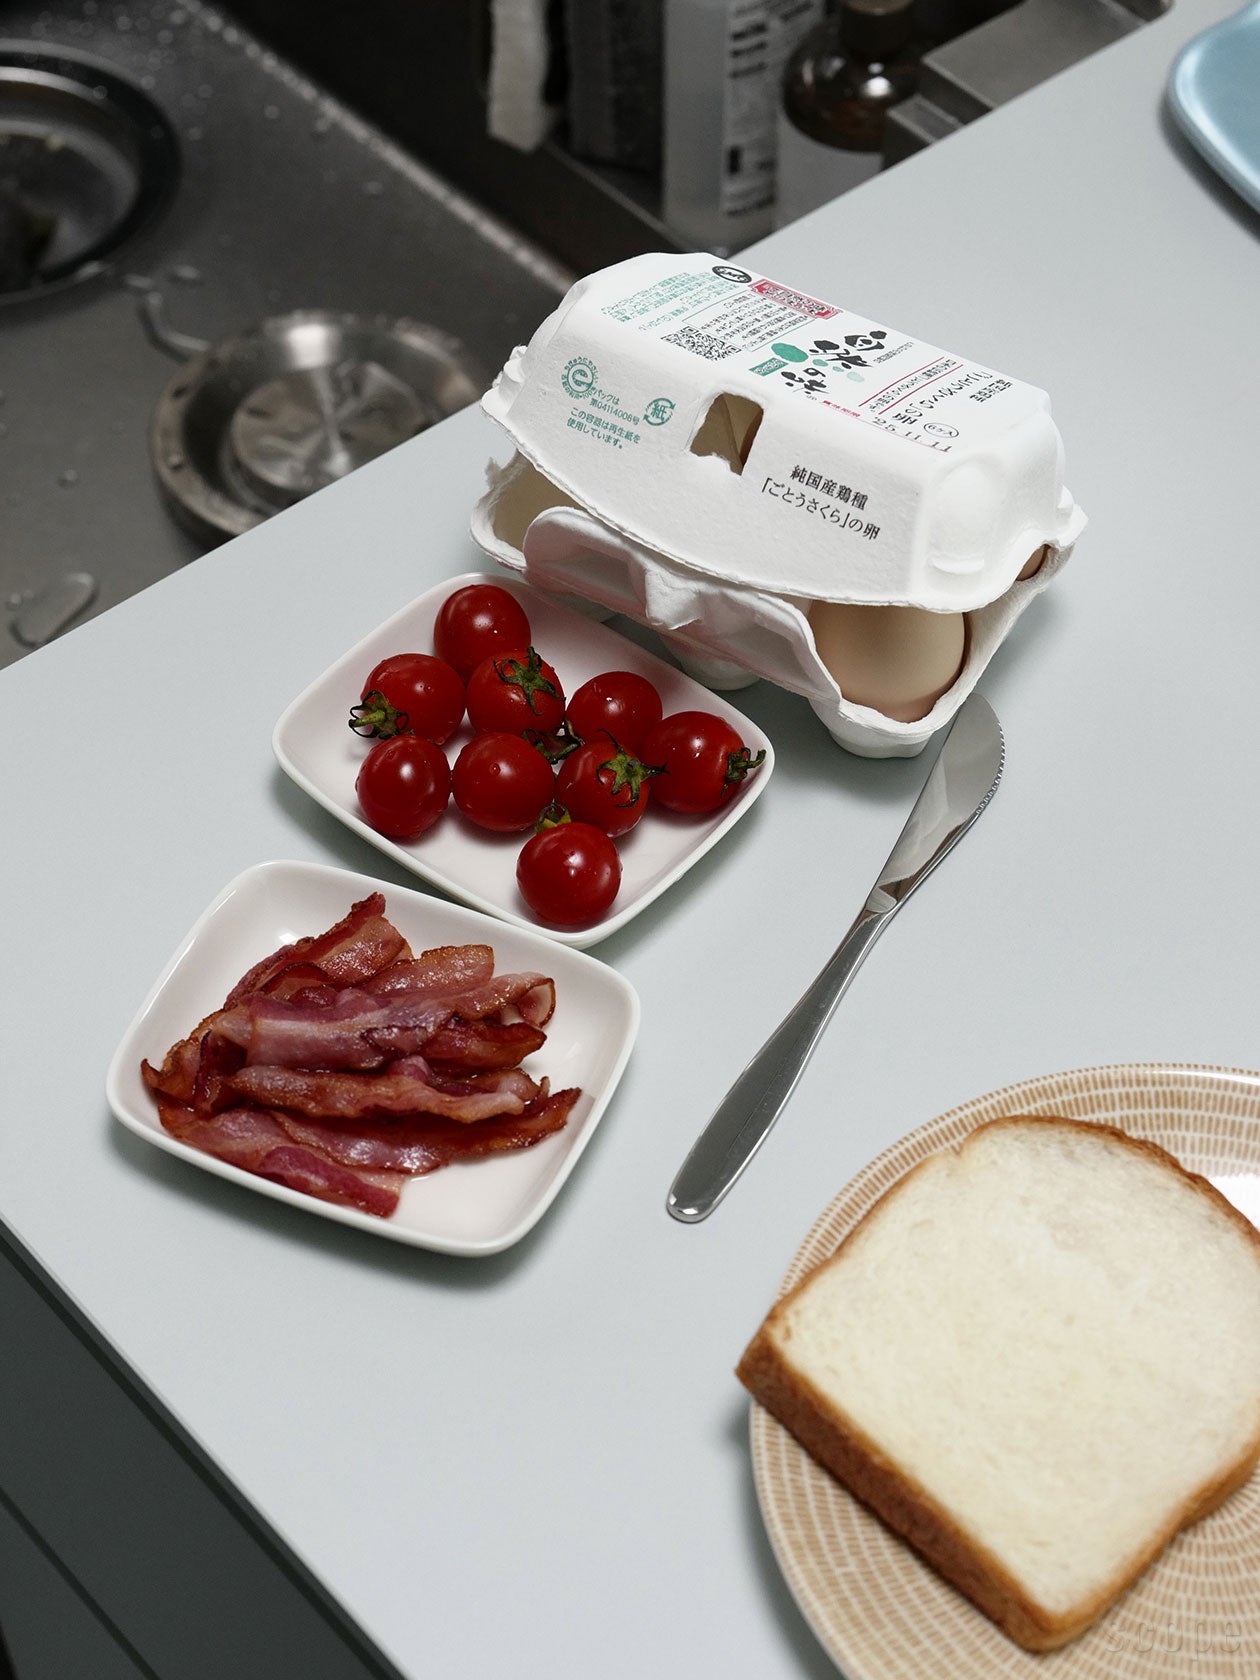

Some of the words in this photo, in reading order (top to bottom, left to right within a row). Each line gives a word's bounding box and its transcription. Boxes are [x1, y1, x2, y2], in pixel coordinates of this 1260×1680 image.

[566, 417, 623, 449] 使用しています。
[571, 407, 641, 443] この容器は再生紙を
[789, 464, 869, 511] 純国産鶏種
[761, 477, 881, 540] 「ごとうさくら」の卵
